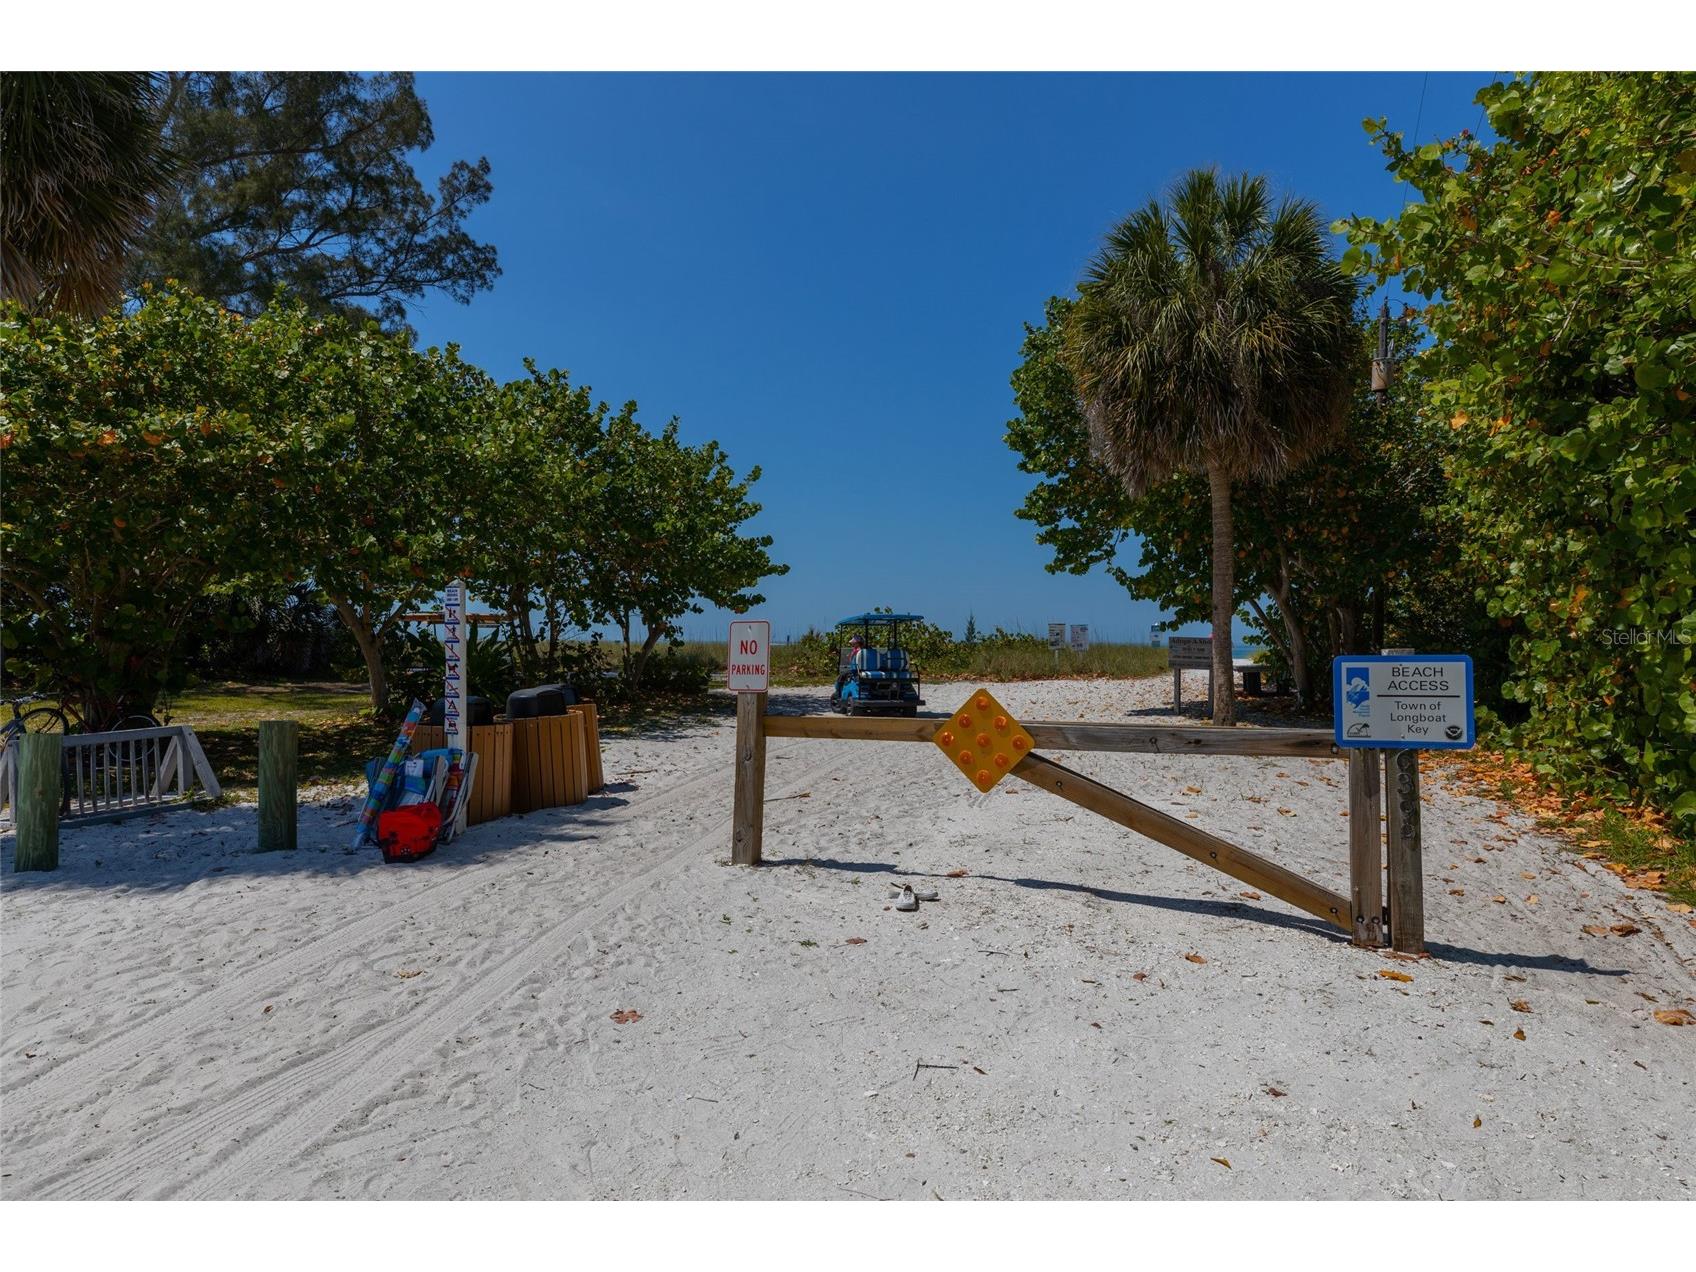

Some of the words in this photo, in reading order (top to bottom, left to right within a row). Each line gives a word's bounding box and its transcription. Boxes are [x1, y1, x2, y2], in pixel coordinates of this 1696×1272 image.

[740, 640, 758, 655] NO
[731, 664, 766, 675] PARKING
[1391, 666, 1444, 677] BEACH
[1387, 680, 1449, 691] ACCESS
[1394, 701, 1427, 710] Town
[1429, 701, 1442, 710] of
[1390, 713, 1446, 724] Longboat
[1407, 724, 1429, 735] Key
